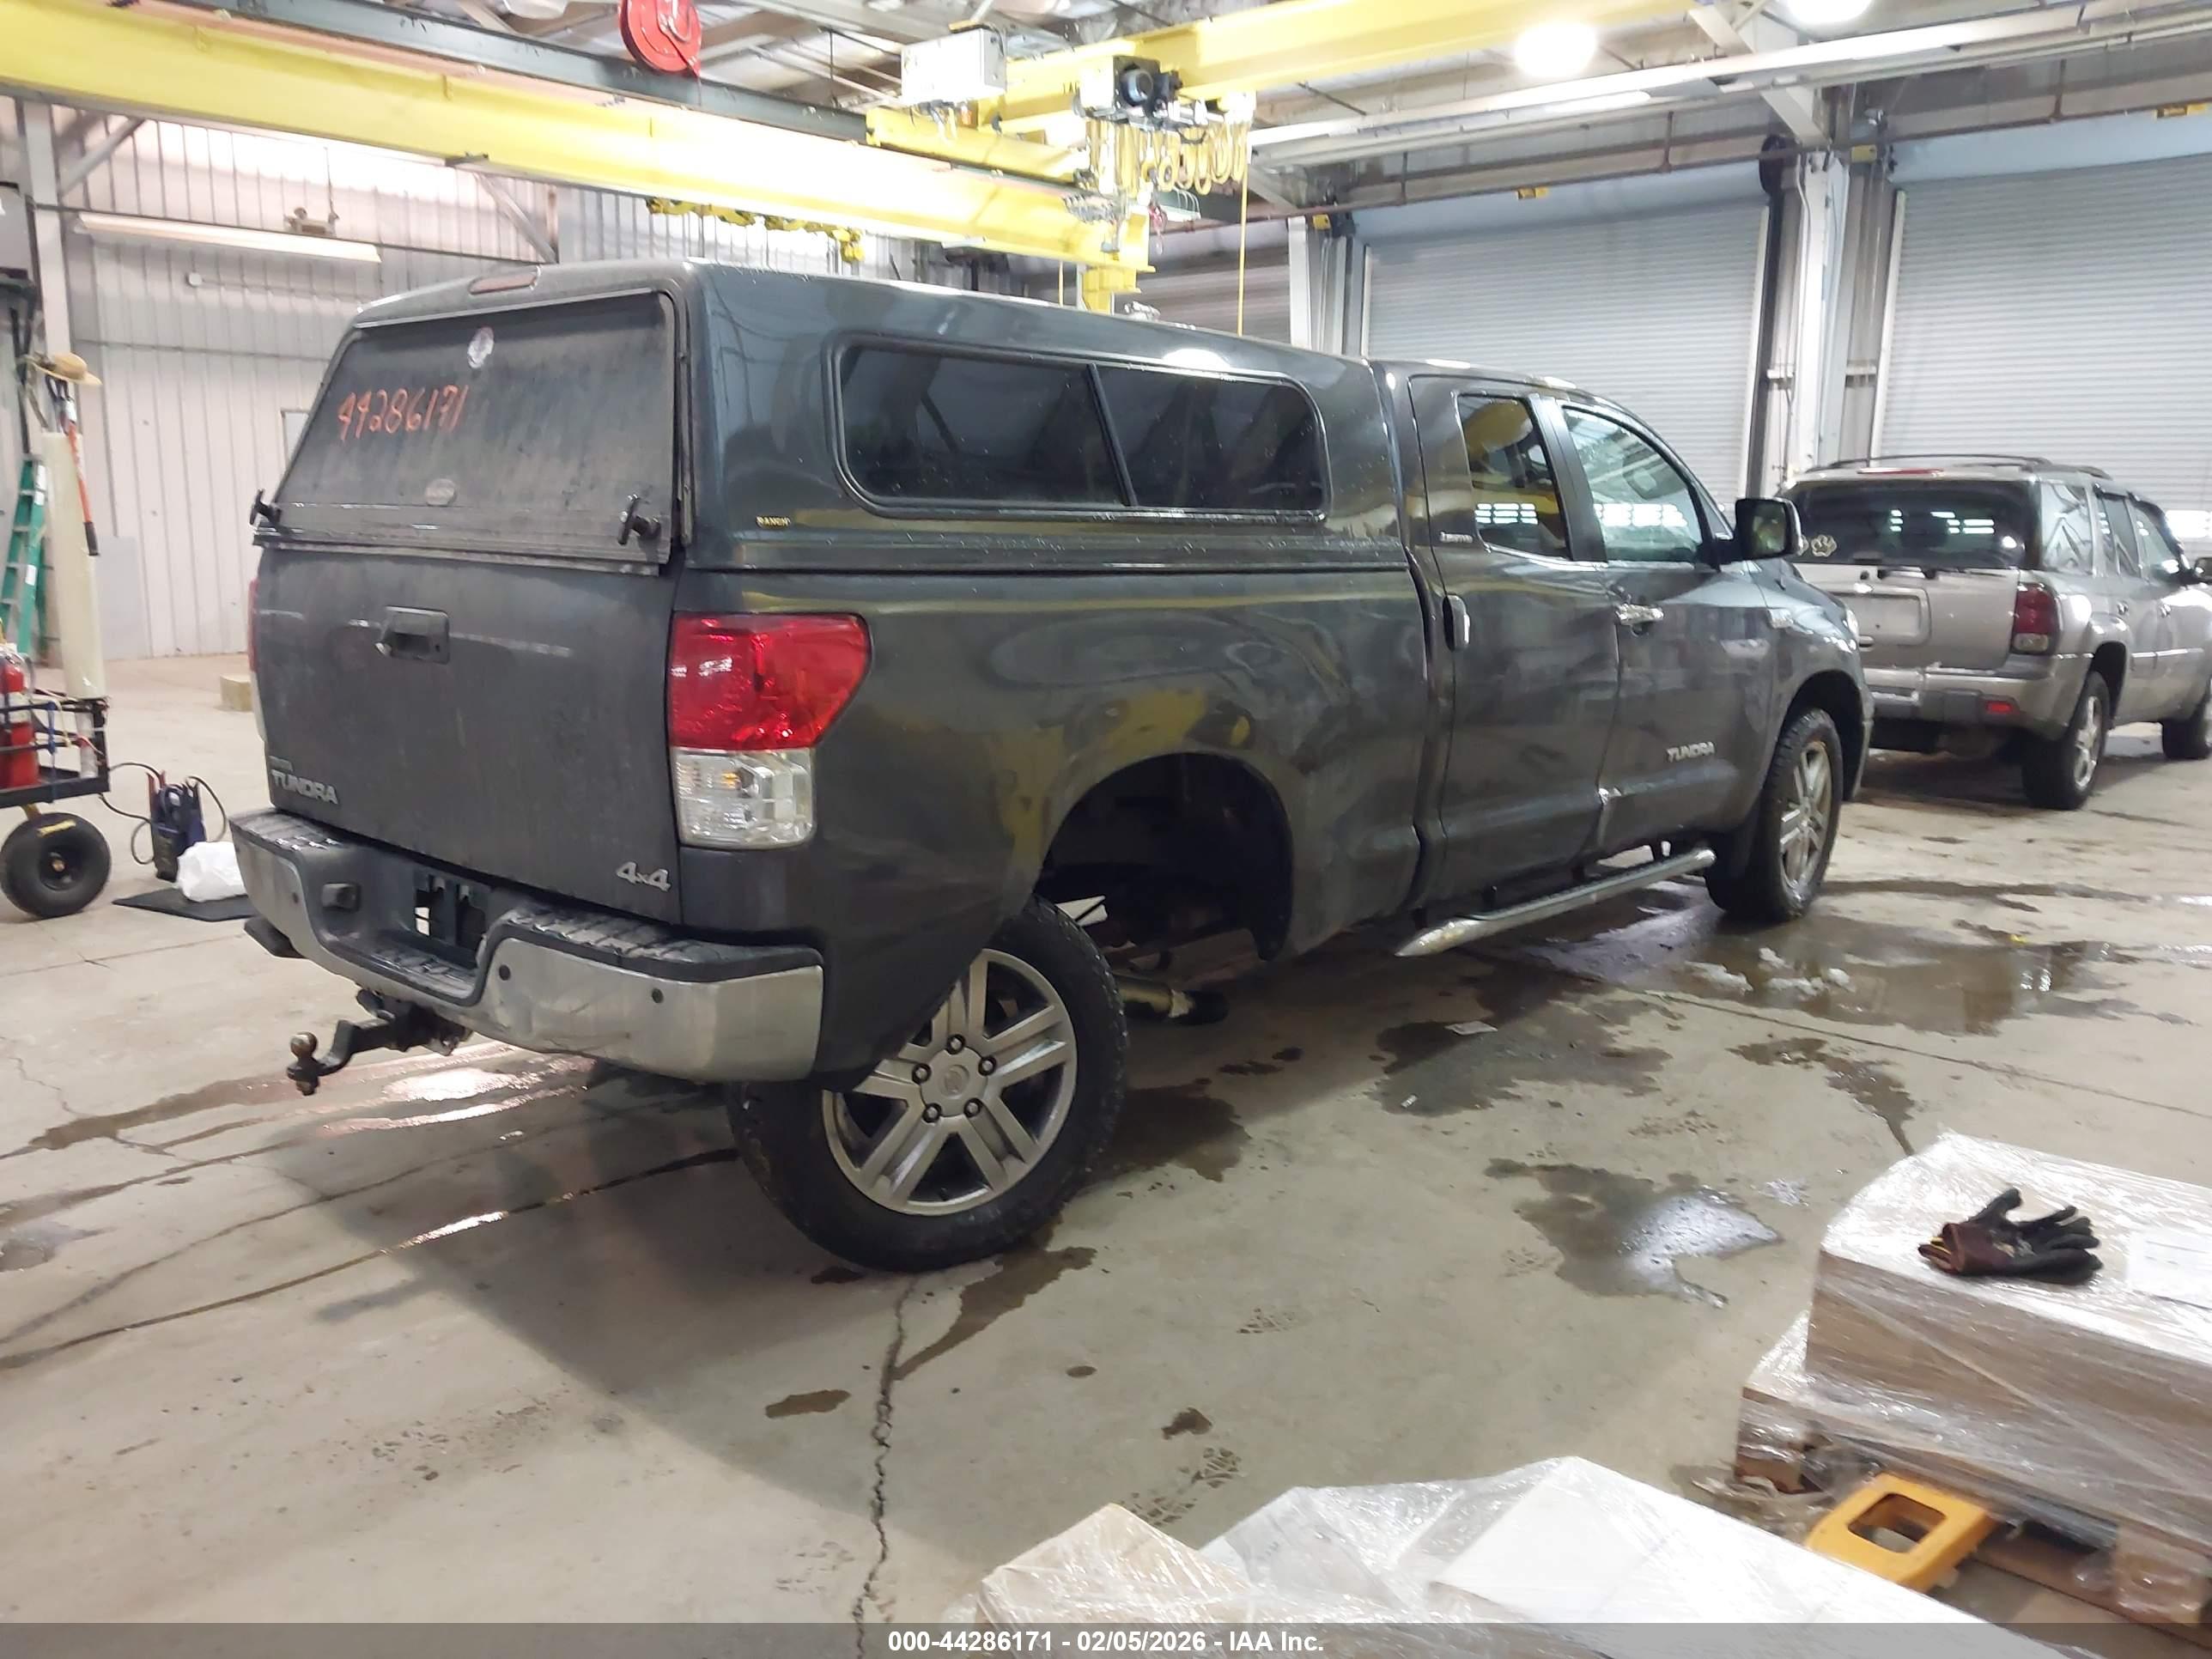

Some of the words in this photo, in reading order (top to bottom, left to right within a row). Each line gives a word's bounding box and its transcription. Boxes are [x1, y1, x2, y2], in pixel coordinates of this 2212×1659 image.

[338, 385, 470, 441] 44286171
[1666, 741, 1716, 763] TUNDRA
[270, 769, 338, 805] TUNDRA
[617, 861, 672, 891] 4x4
